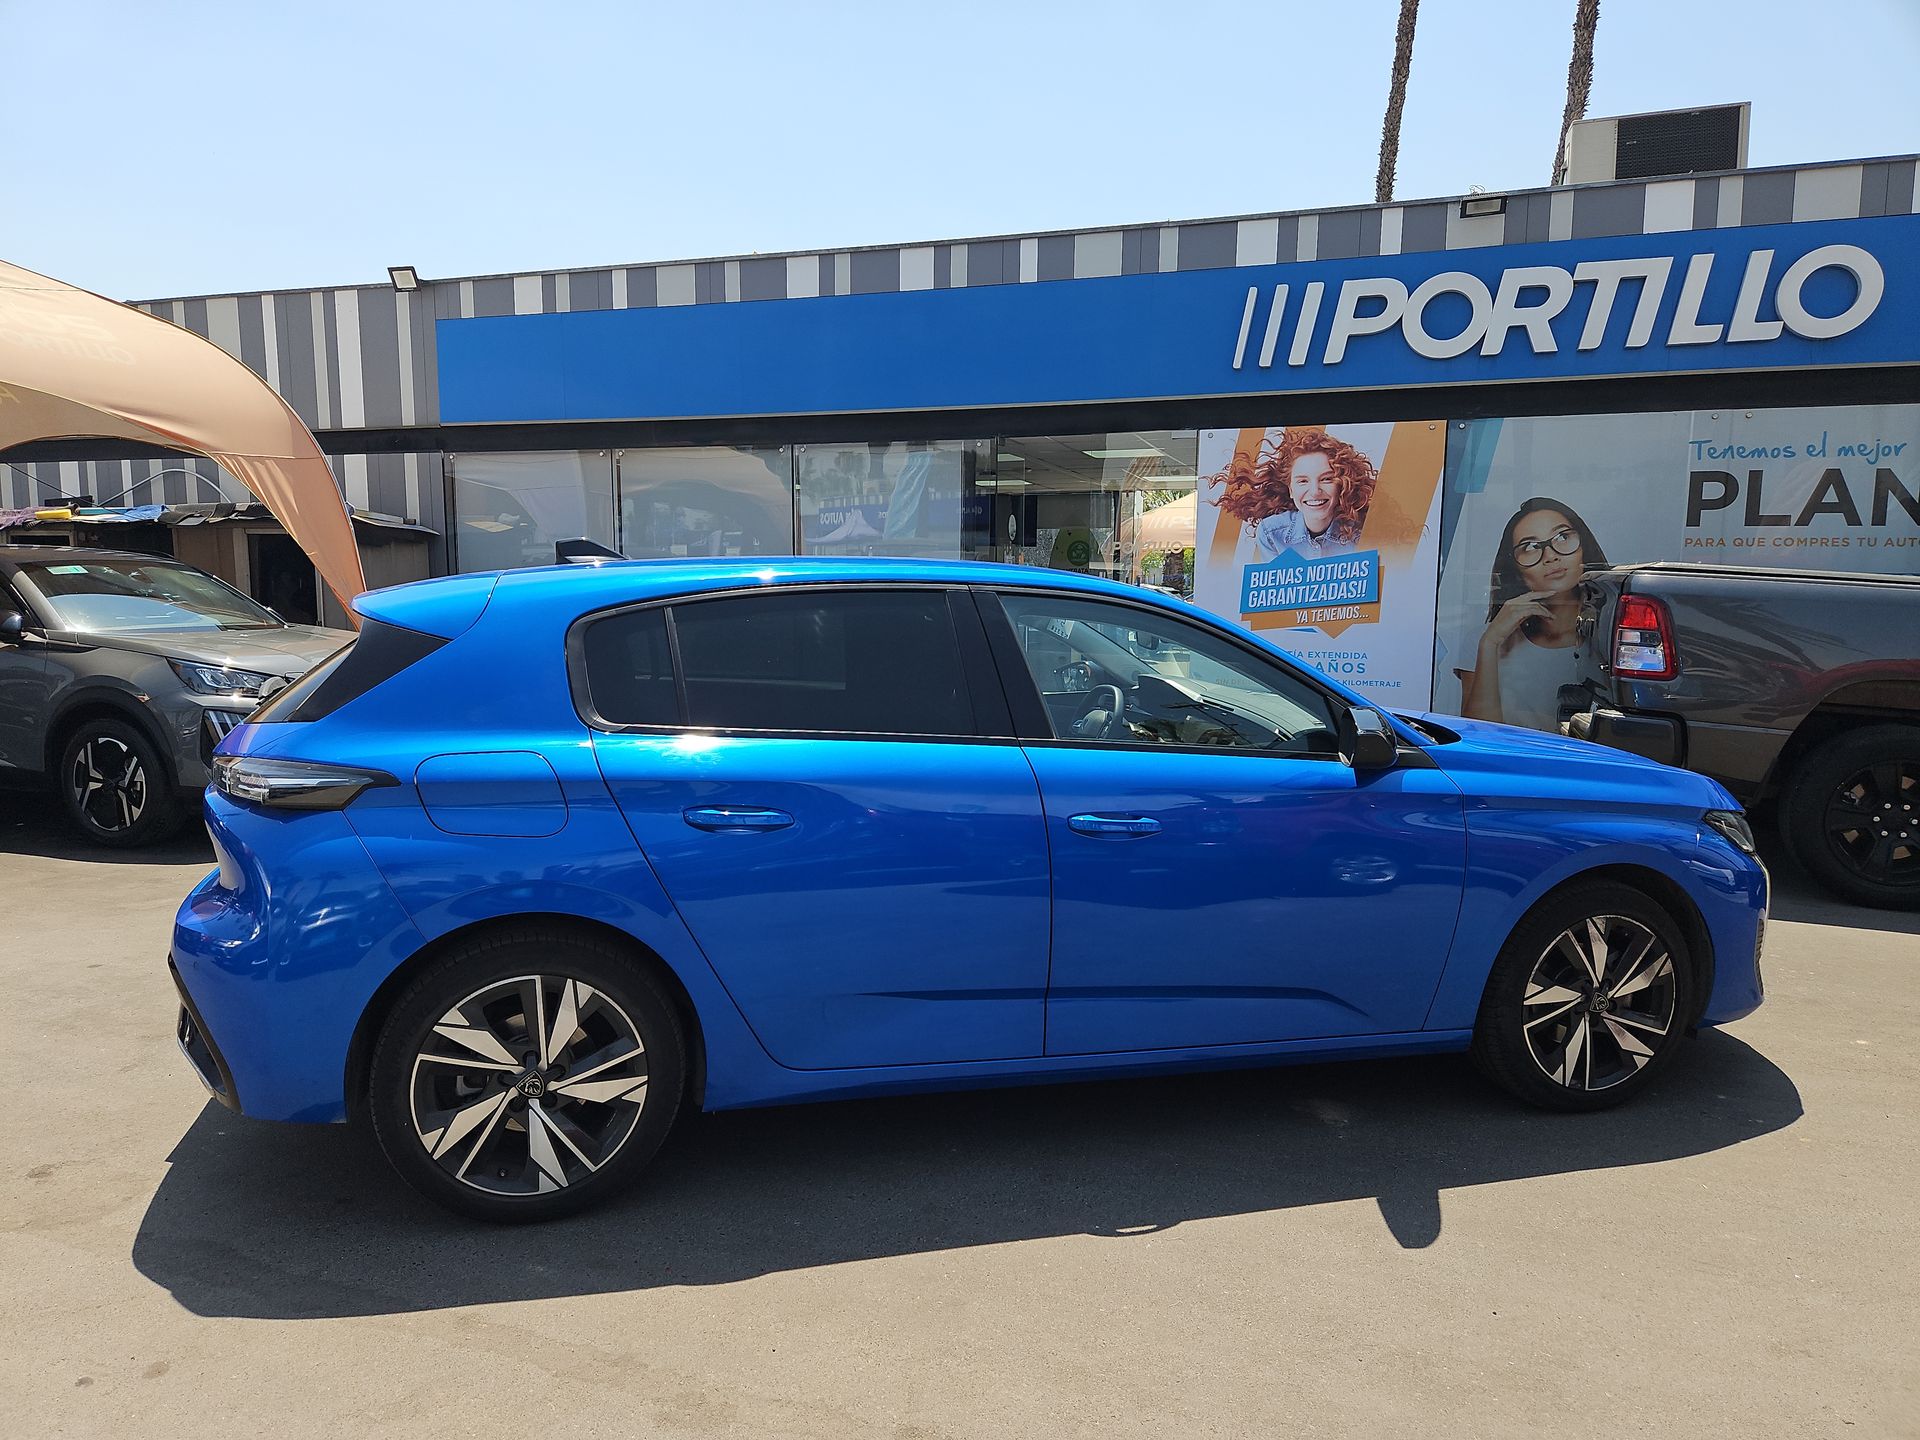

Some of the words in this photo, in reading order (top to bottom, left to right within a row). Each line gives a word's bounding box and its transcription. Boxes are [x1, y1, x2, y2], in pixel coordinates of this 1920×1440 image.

[1324, 244, 1885, 366] PORTILLO
[1689, 438, 1796, 460] Tenemos
[1806, 431, 1828, 458] el
[1837, 438, 1908, 465] mejor
[1685, 467, 1920, 527] PLAN
[1684, 537, 1727, 548] PARA
[1733, 537, 1766, 549] QUE
[1772, 537, 1851, 548] COMPRES
[1857, 537, 1878, 547] TU
[1884, 537, 1920, 548] AUT
[1250, 566, 1303, 588] BUENAS
[1306, 560, 1370, 583] NOTICIAS
[1248, 580, 1368, 609] GARANTIZADAS!!
[1296, 611, 1308, 624] YA
[1311, 605, 1369, 622] TENEMOS...
[1308, 651, 1368, 660] EXTENDIDA
[1315, 659, 1366, 674] AÑOS
[1342, 679, 1402, 689] KILOMETRAJE
